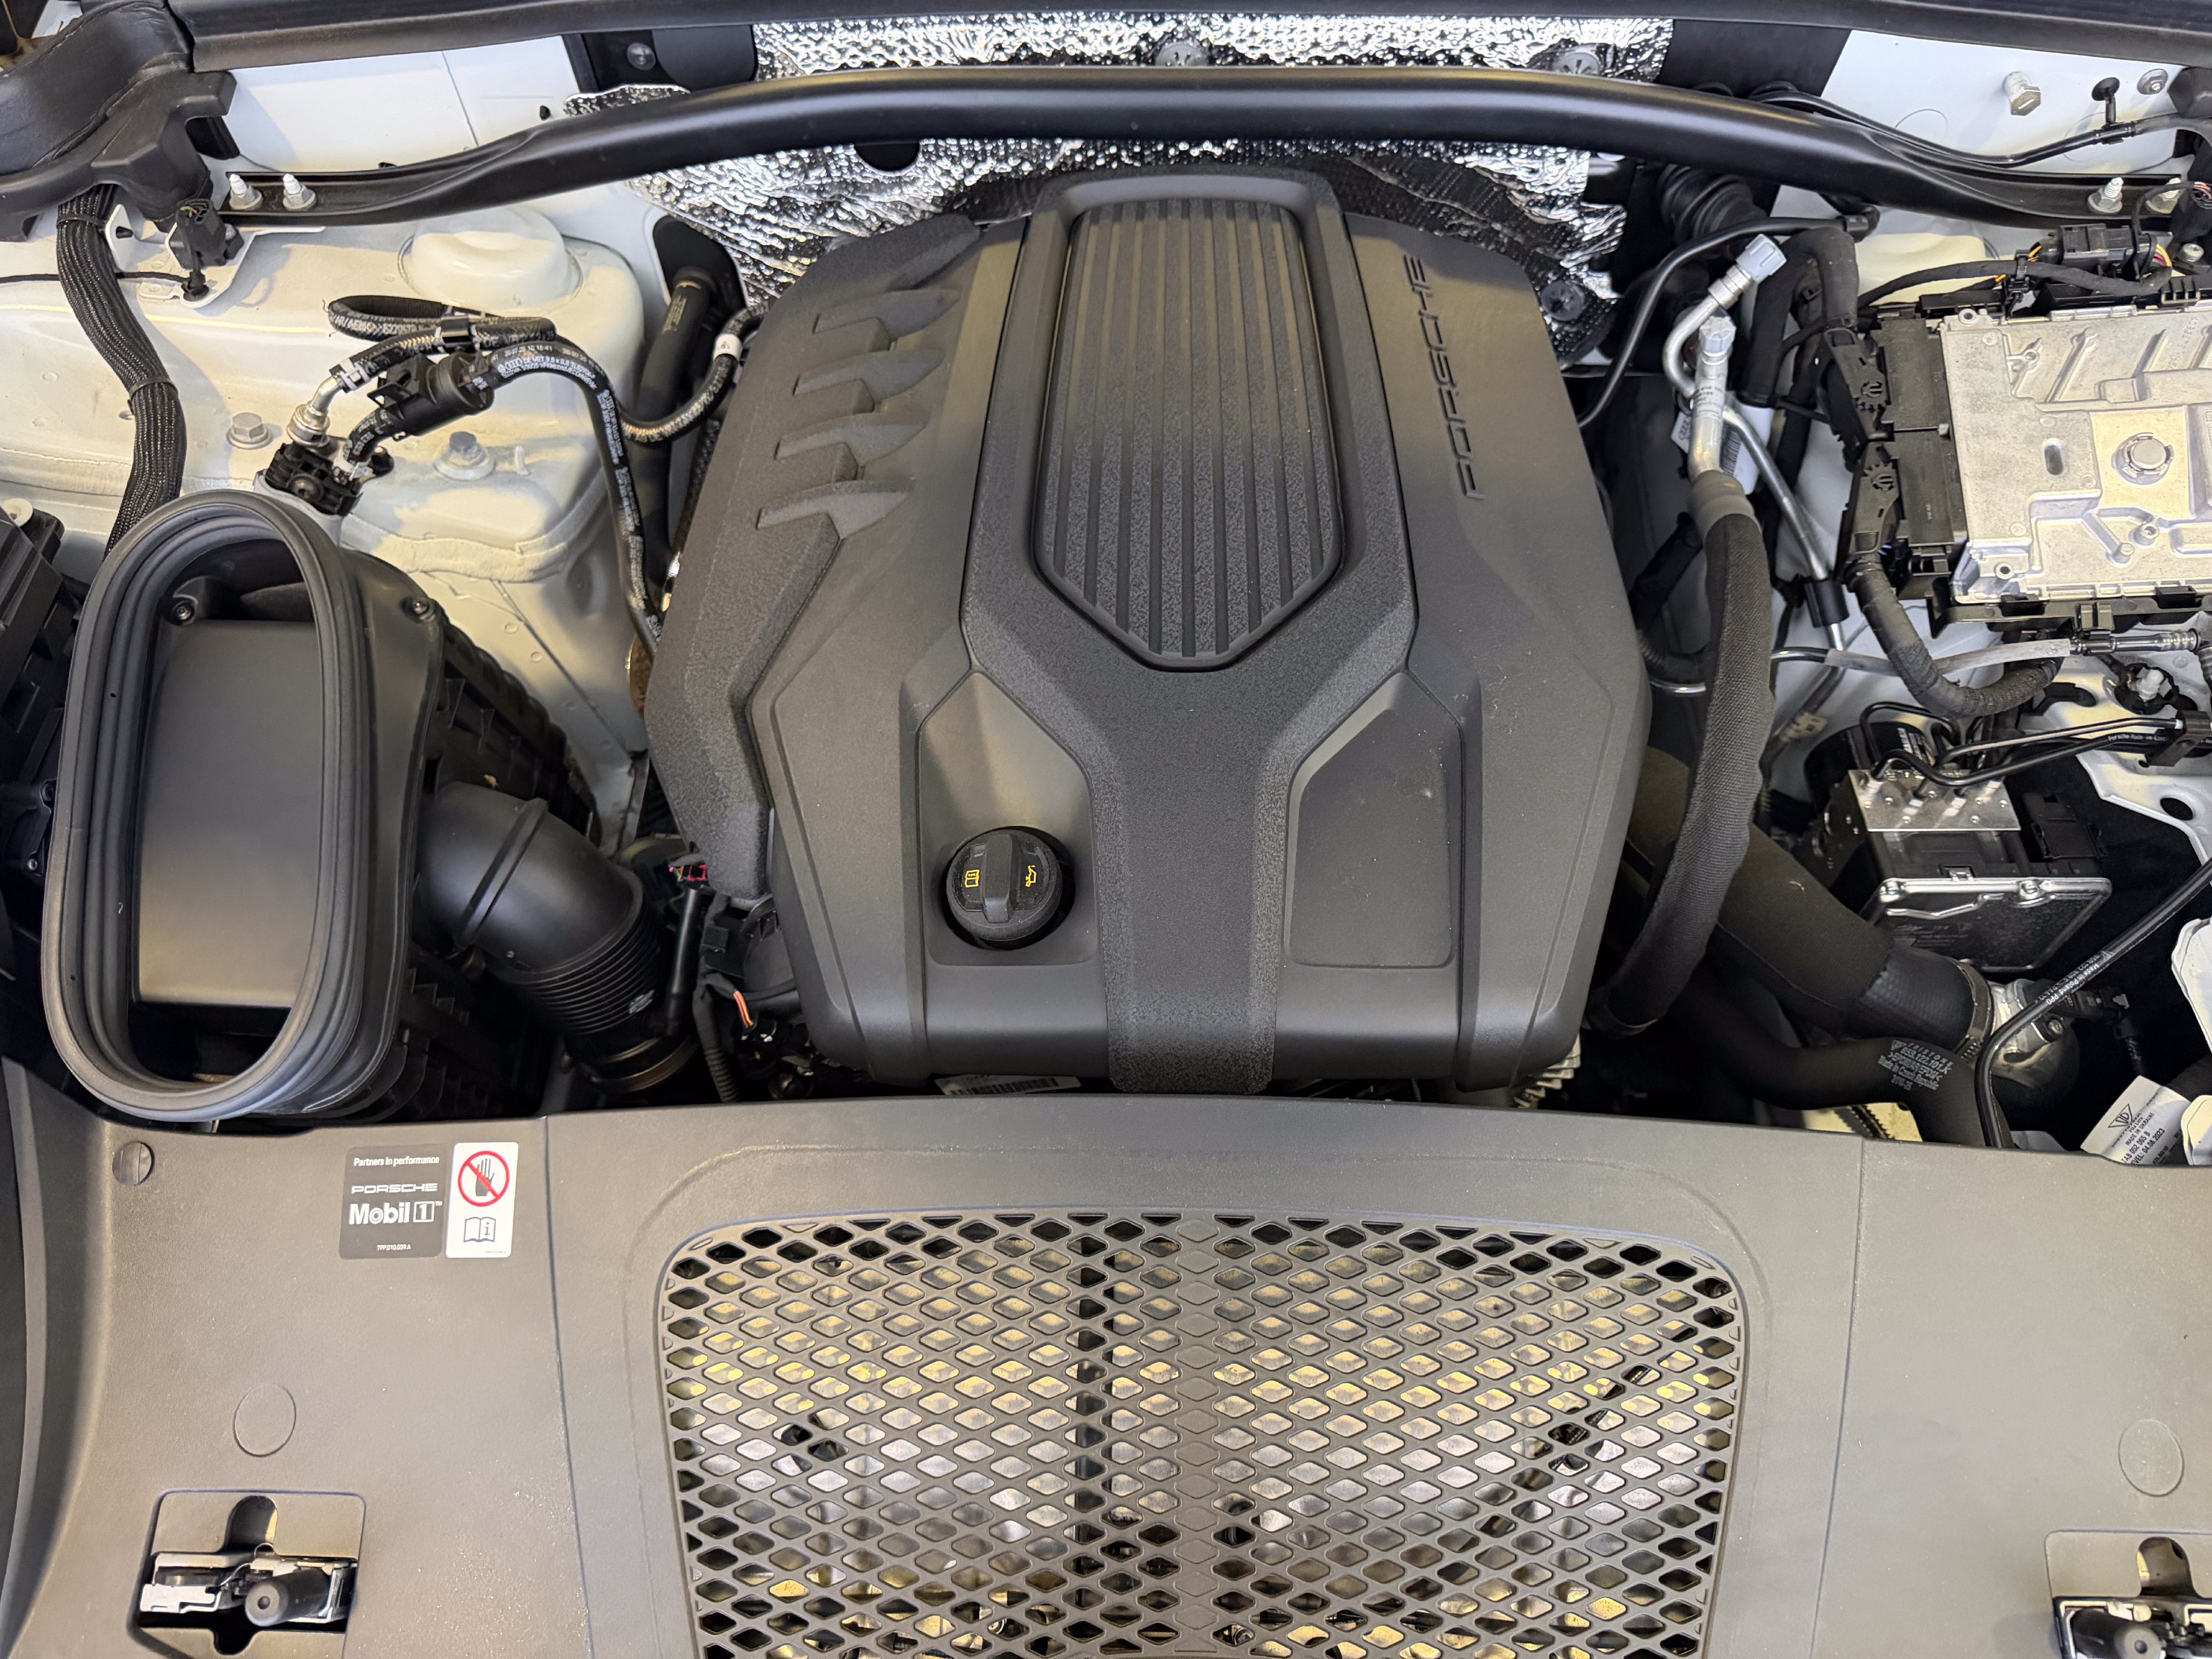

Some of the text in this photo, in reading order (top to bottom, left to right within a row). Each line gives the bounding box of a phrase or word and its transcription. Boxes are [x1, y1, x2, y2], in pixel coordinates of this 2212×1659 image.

[1404, 254, 1486, 500] PORSCHE
[2085, 962, 2100, 975] Made
[2077, 973, 2085, 981] in
[2058, 978, 2080, 995] Poland
[2125, 1134, 2137, 1145] MADE
[2139, 1112, 2155, 1129] UKRAINE
[354, 1156, 440, 1167] Partners in performance
[351, 1183, 439, 1194] PORSCHE
[349, 1202, 411, 1225] Mobil
